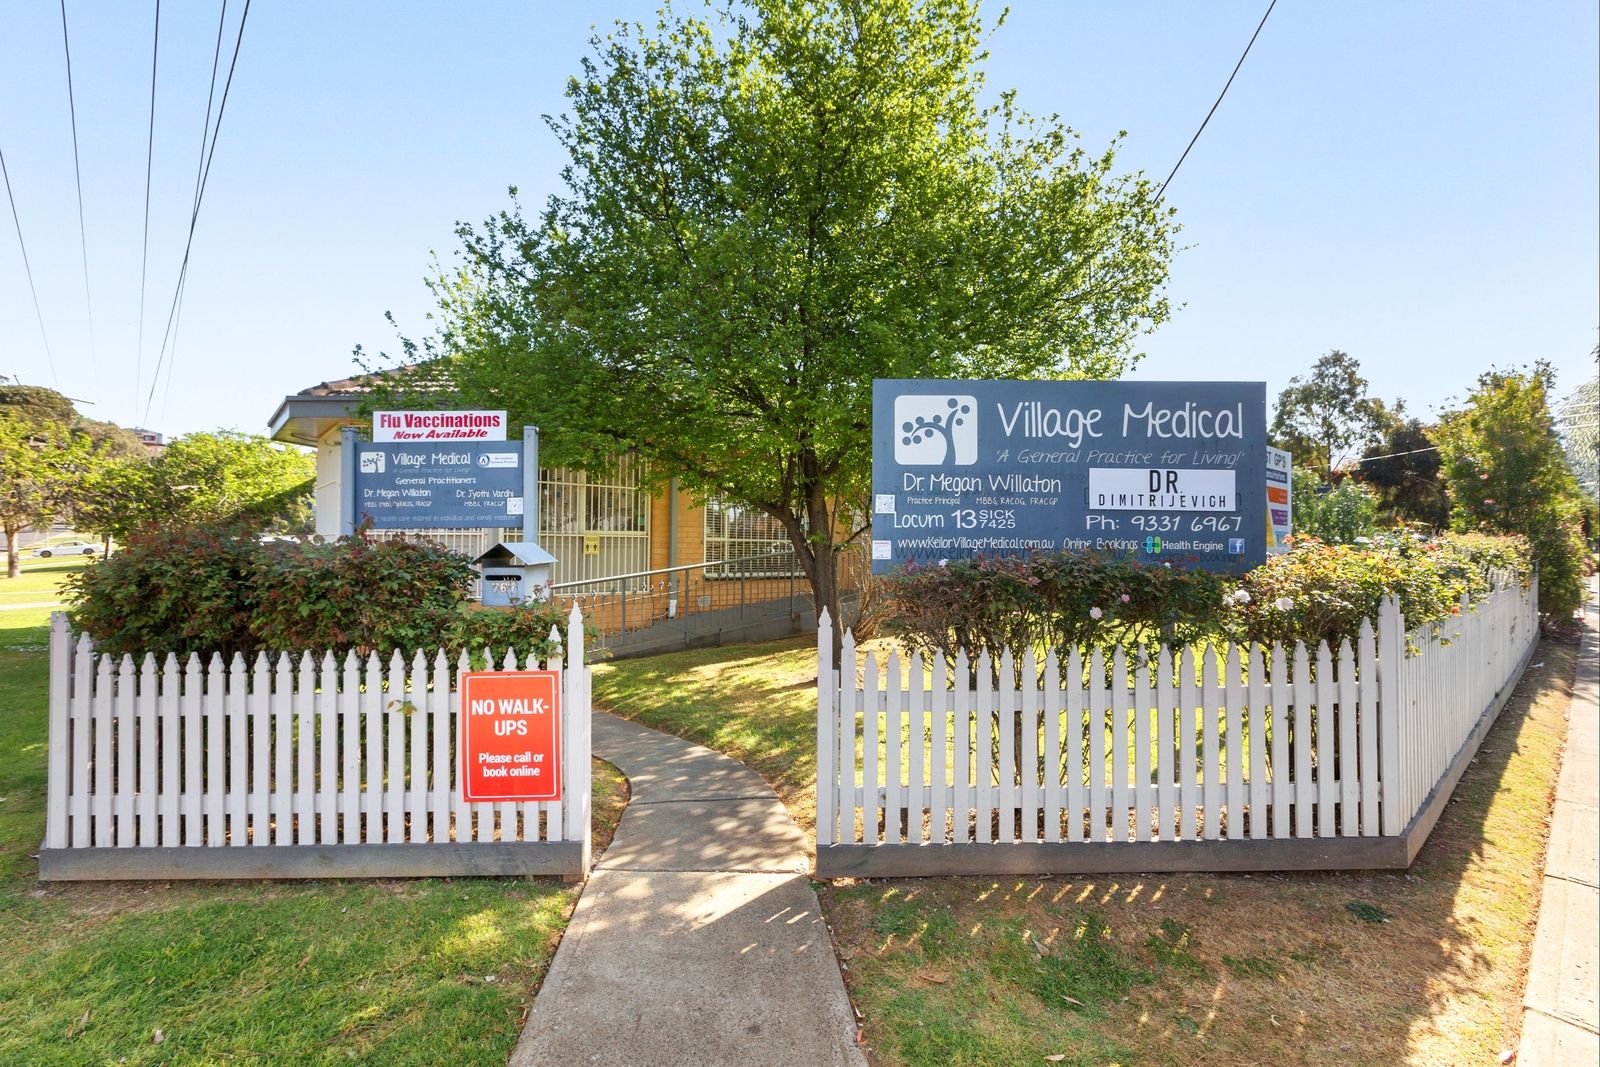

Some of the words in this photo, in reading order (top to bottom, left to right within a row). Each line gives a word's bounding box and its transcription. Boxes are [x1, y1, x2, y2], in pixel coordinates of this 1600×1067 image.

[380, 414, 401, 428] Flu
[404, 413, 500, 428] Vaccinations
[997, 401, 1103, 449] Village
[1122, 401, 1243, 439] Medical
[393, 430, 424, 440] Now
[425, 429, 488, 439] Available
[392, 452, 426, 469] Village
[431, 452, 471, 465] Medical
[1017, 449, 1081, 464] General
[1086, 449, 1152, 464] Practice
[1160, 450, 1187, 465] for
[395, 477, 426, 485] General
[428, 476, 477, 485] Practitioners
[903, 472, 925, 492] Dr.
[930, 473, 982, 497] Megan
[988, 474, 1062, 493] Willaton
[364, 489, 376, 498] Dr.
[377, 489, 400, 500] Megan
[402, 488, 432, 497] Willaton
[907, 496, 933, 505] Practice
[935, 496, 961, 507] Principal
[1029, 497, 1059, 506] FRACGP
[894, 511, 945, 529] Locum
[951, 509, 978, 529] 13
[979, 509, 1015, 519] SICK
[979, 519, 1016, 529] 7425
[1086, 515, 1120, 530] Ph:
[1131, 515, 1181, 531] 9331
[1190, 516, 1242, 532] 6967
[1063, 537, 1092, 551] Online
[1096, 537, 1139, 554] Bookings
[1162, 540, 1191, 550] Health
[1193, 541, 1224, 552] Engine
[471, 699, 495, 715] NO
[498, 698, 550, 715] WALK-
[494, 719, 528, 736] UPS
[479, 752, 512, 763] Please
[513, 751, 531, 763] call
[533, 754, 544, 762] or
[483, 766, 508, 777] book
[509, 765, 540, 777] online
